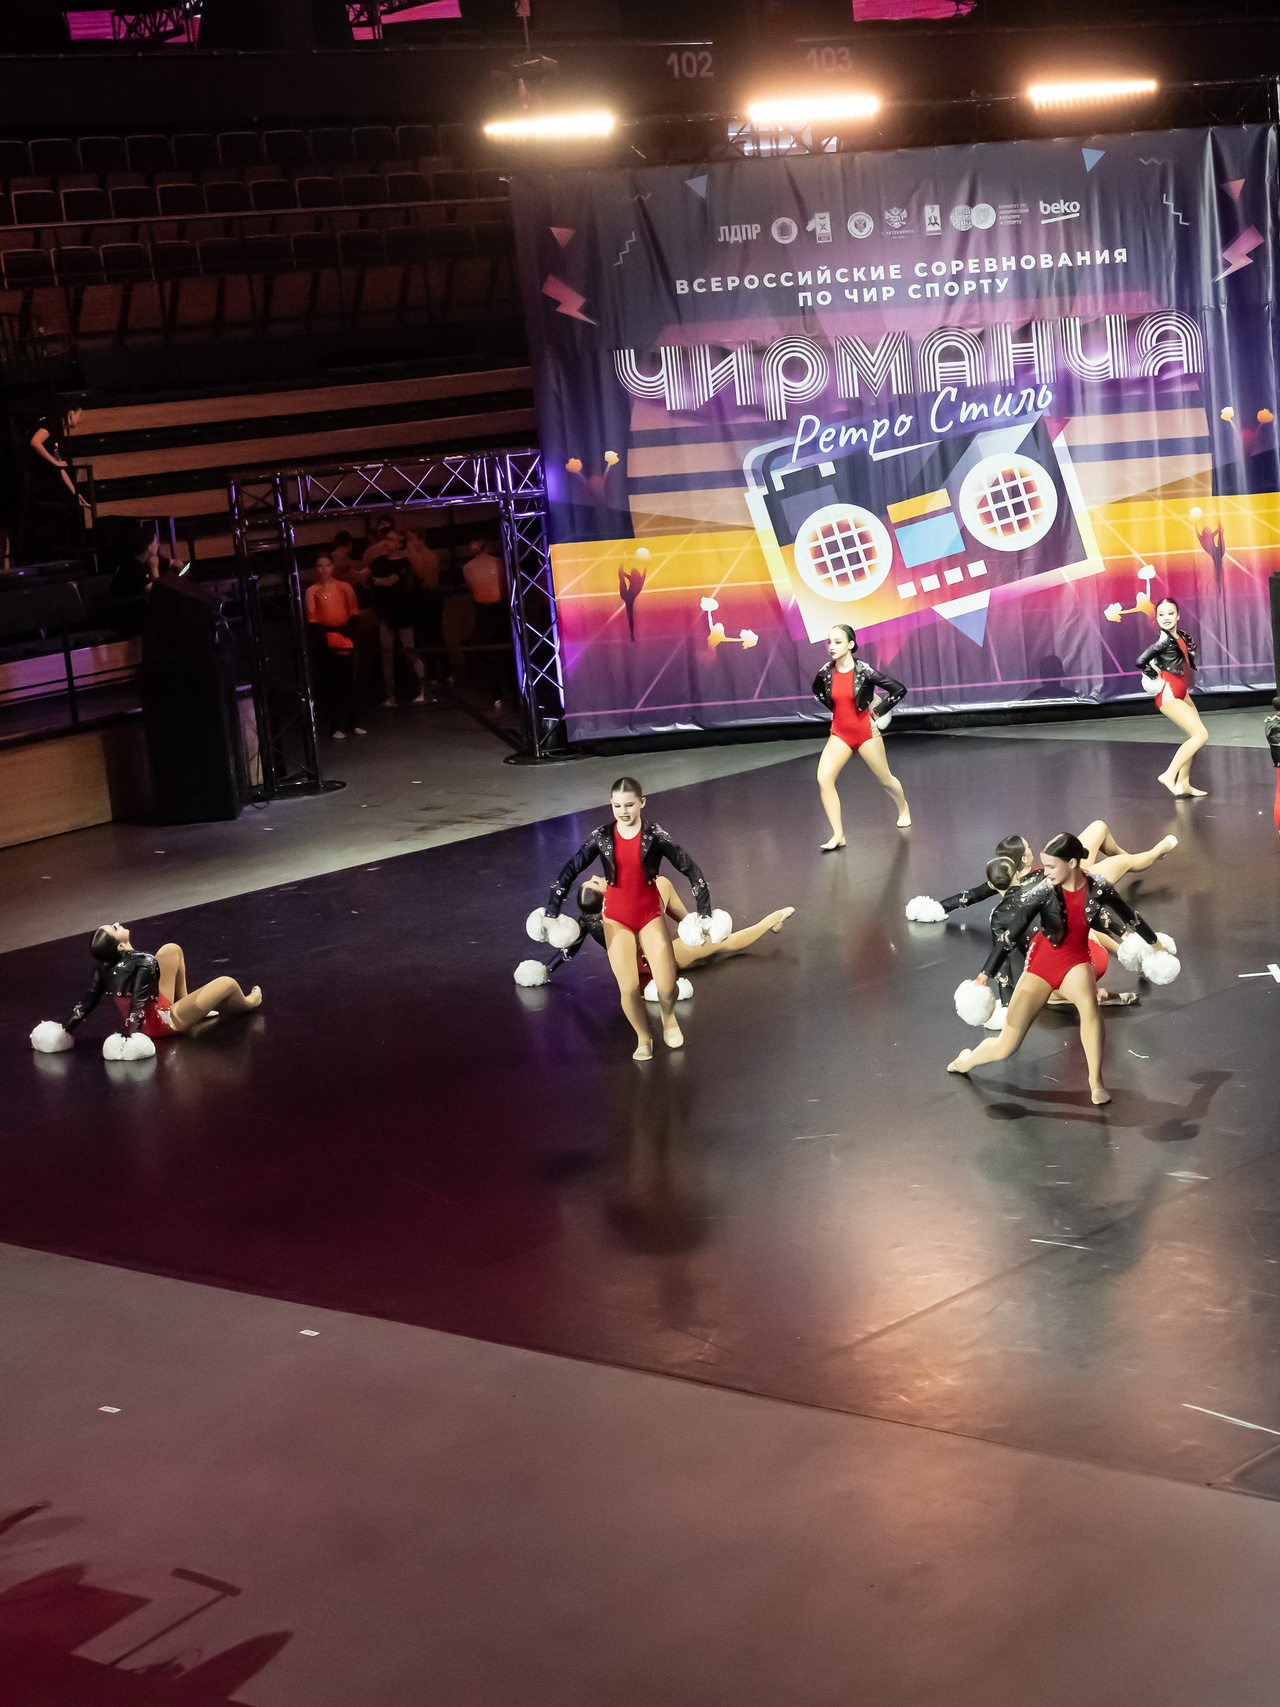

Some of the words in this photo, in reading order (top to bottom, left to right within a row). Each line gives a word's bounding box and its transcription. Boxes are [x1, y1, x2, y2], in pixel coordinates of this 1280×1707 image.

[666, 51, 714, 78] 102
[805, 46, 853, 72] 103
[1039, 199, 1081, 215] beko
[717, 223, 762, 244] ЛДПР
[675, 264, 903, 295] ВСЕРОССИЙСКИЕ
[914, 247, 1129, 279] СОРЕВНОВАНИЯ
[798, 290, 832, 307] ПО
[844, 286, 896, 303] ЧИР
[912, 276, 1010, 299] СПОРТУ
[791, 414, 914, 463] Ретро
[929, 384, 1054, 433] Стиль
